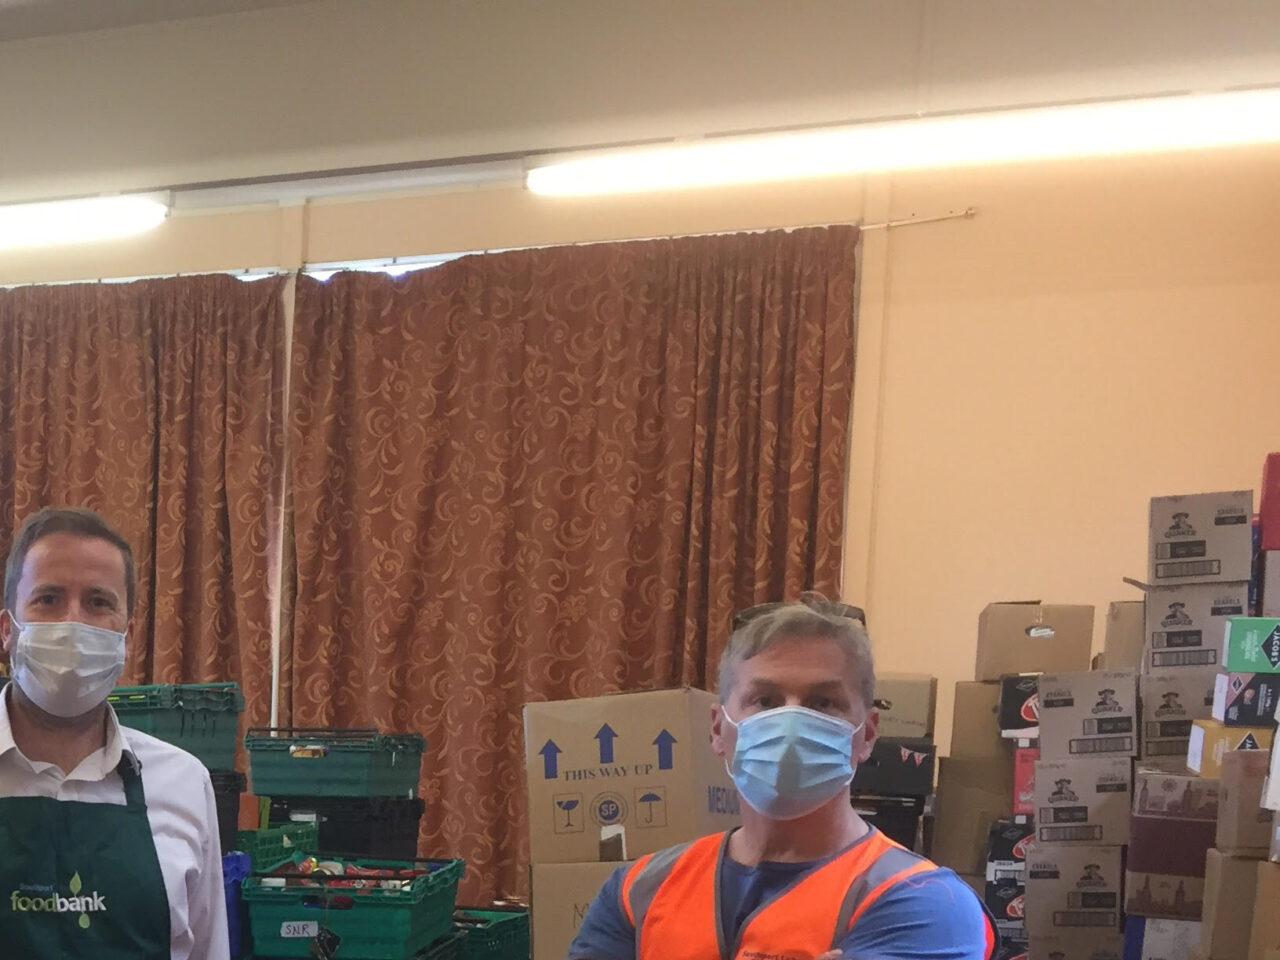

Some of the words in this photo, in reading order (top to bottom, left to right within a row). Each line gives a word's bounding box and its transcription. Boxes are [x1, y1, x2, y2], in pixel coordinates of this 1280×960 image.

[563, 769, 597, 781] THIS
[599, 766, 629, 778] WAY
[634, 764, 653, 775] UP
[601, 804, 618, 816] SP
[10, 890, 107, 912] foodbank
[285, 924, 310, 936] SNR
